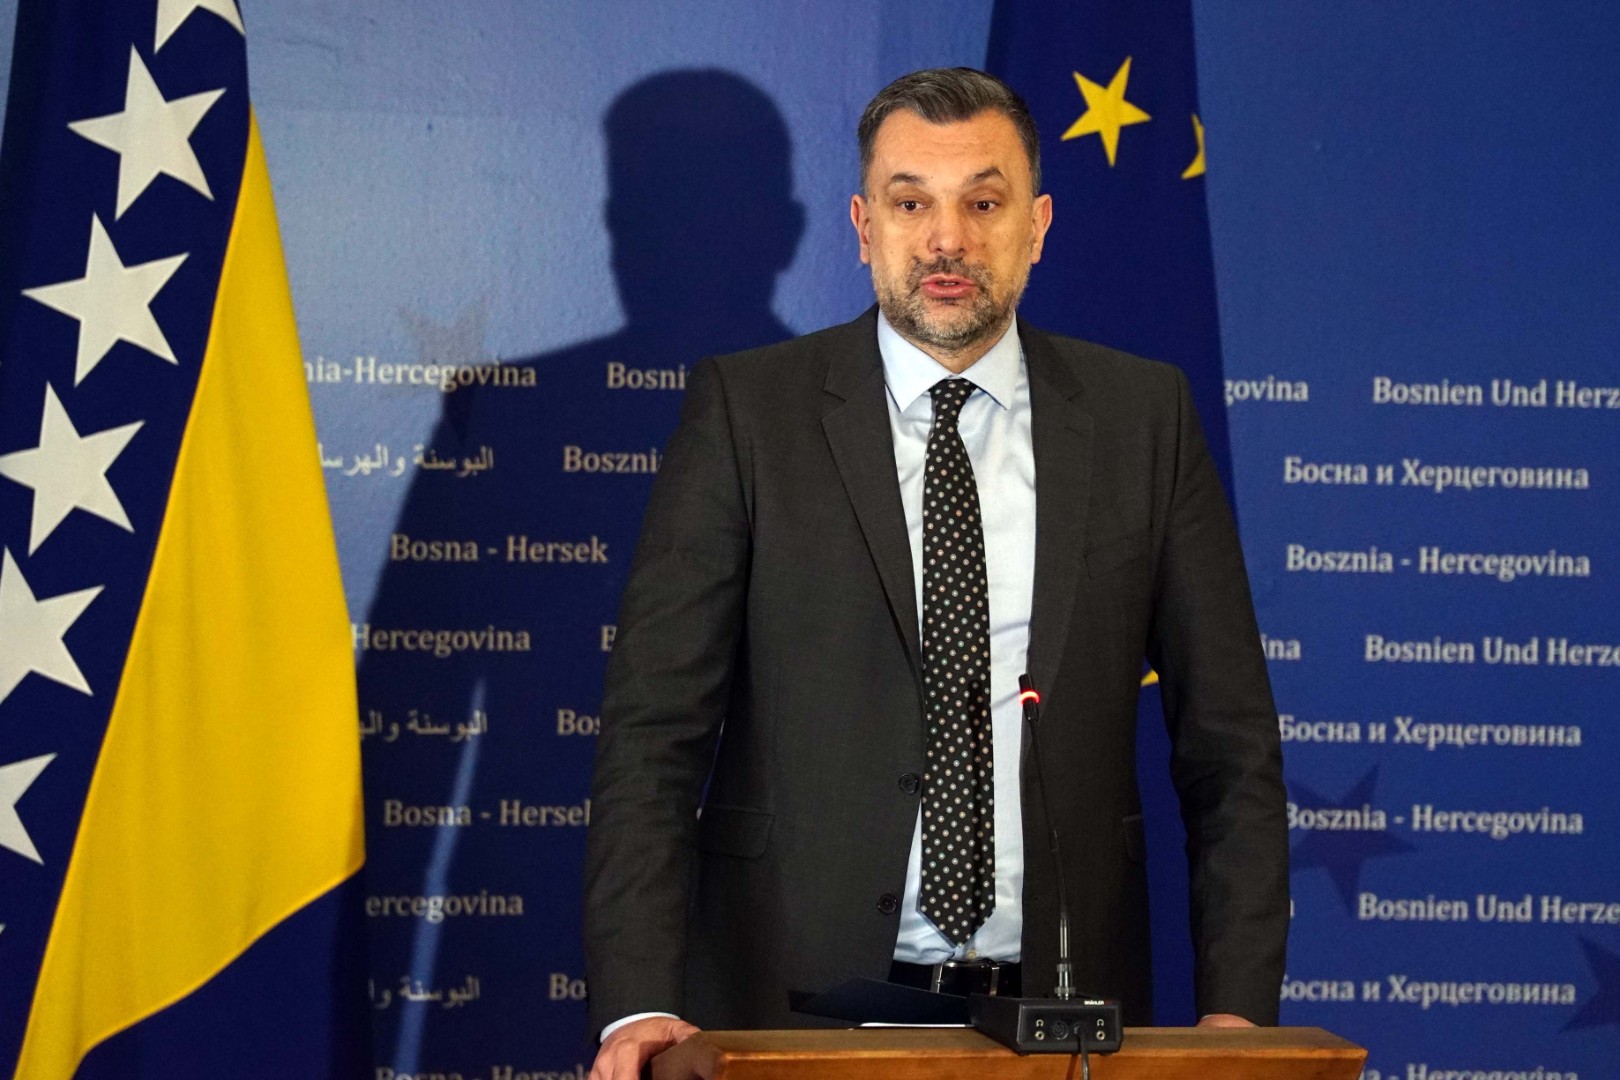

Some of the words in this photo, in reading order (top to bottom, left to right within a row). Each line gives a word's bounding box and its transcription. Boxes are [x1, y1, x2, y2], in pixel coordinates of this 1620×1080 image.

[607, 362, 689, 390] Bosni
[1372, 376, 1483, 406] Bosnien
[1491, 379, 1547, 407] Und
[563, 446, 662, 474] Boszni
[1283, 456, 1368, 485] Босна
[1375, 464, 1394, 485] и
[1401, 458, 1589, 493] Херцеговина
[390, 533, 479, 562] Bosna
[507, 535, 608, 564] Hersek
[1286, 543, 1394, 573] Bosznia
[1418, 546, 1591, 582] Hercegovina
[351, 622, 531, 659] Hercegovina
[1364, 634, 1475, 664] Bosnien
[1483, 637, 1539, 665] Und
[1279, 715, 1361, 743] Босна
[1368, 722, 1387, 744] и
[1393, 716, 1582, 751] Херцеговина
[384, 799, 472, 828] Bosna
[1412, 804, 1584, 840] Hercegovina
[365, 890, 524, 925] ercegovina
[1358, 892, 1469, 921] Bosnien
[1476, 895, 1533, 922] Und
[1362, 981, 1381, 1002] и
[1387, 975, 1576, 1010] Херцеговина
